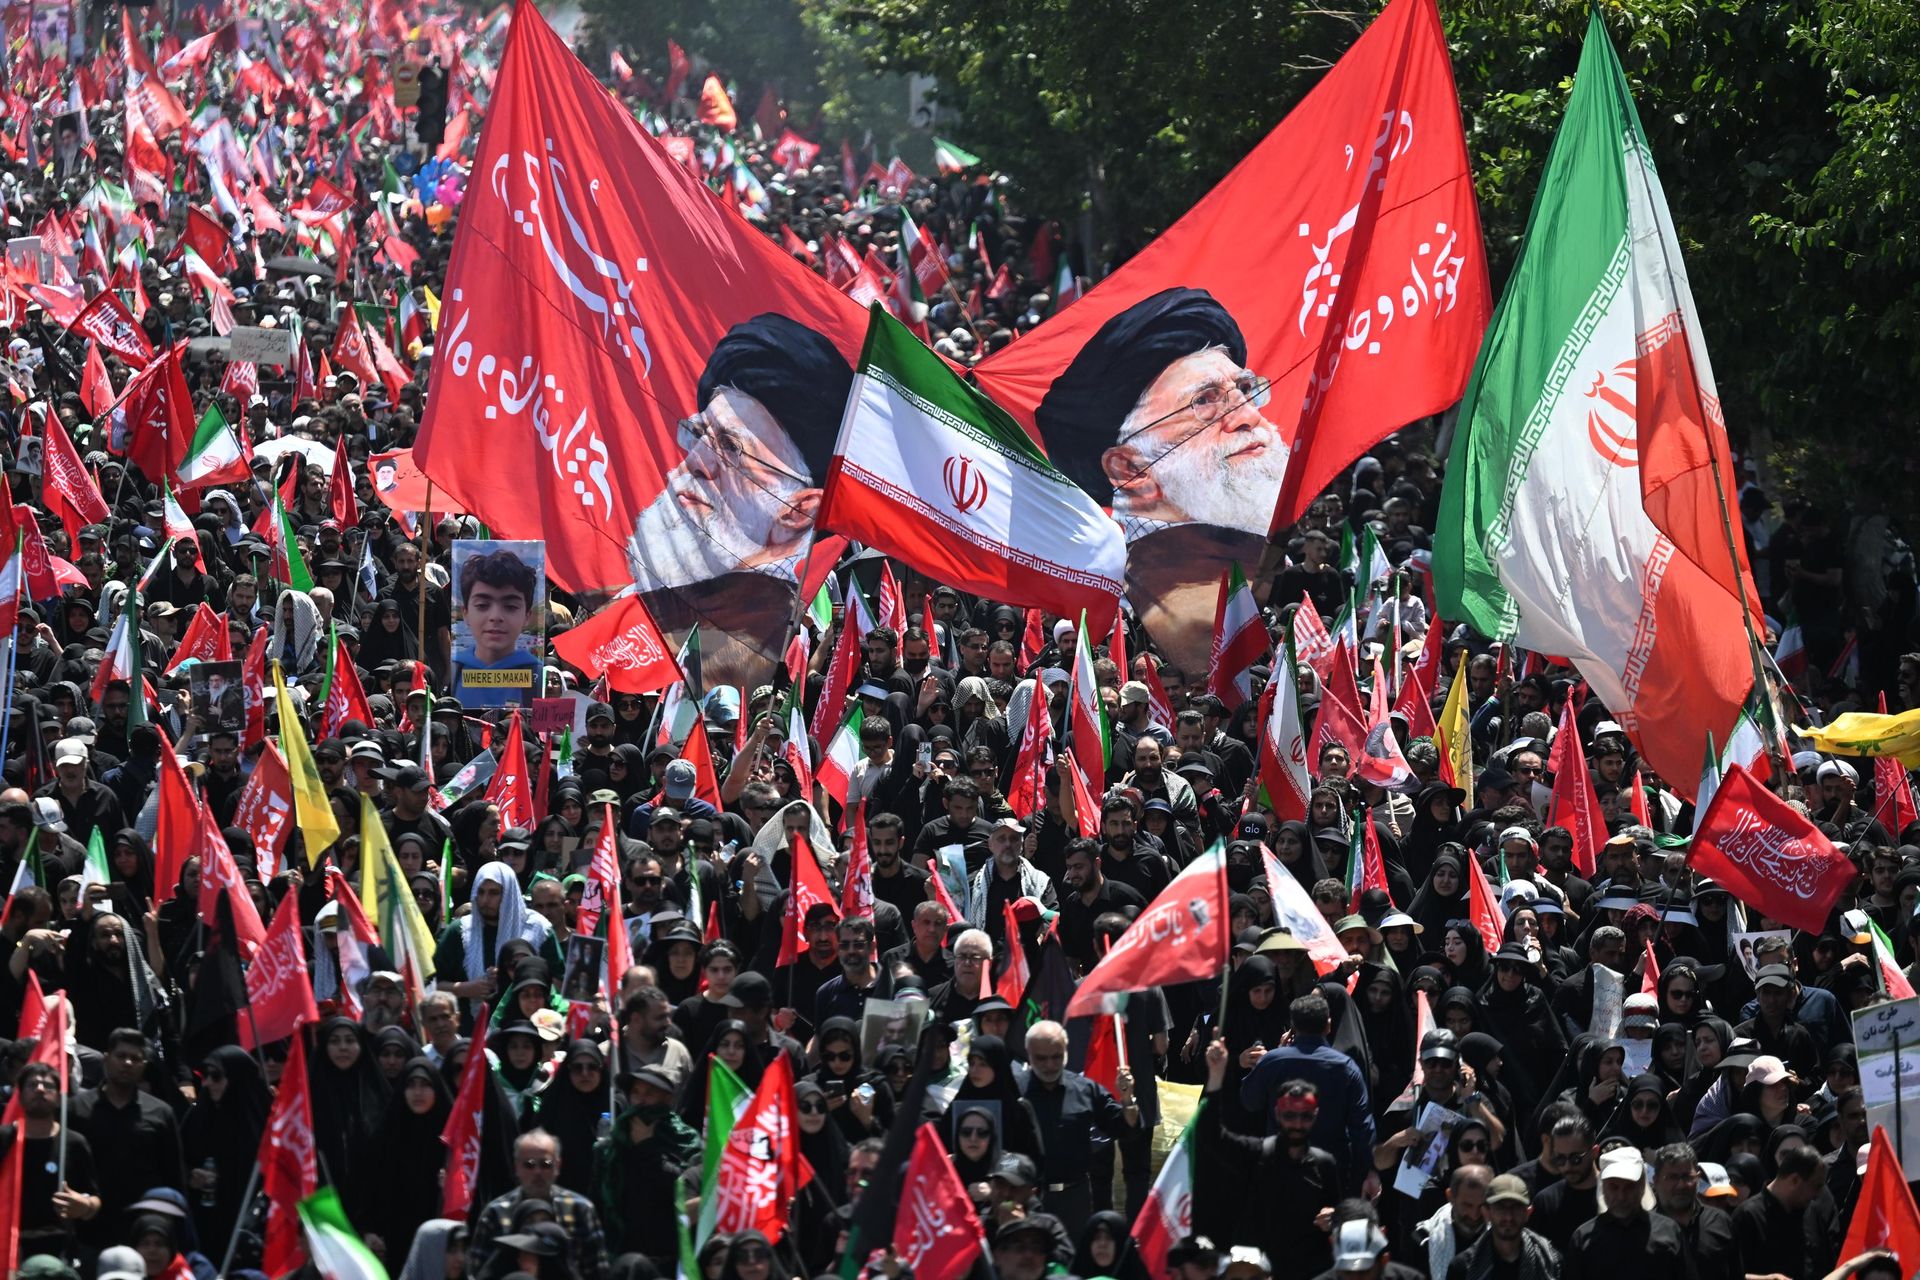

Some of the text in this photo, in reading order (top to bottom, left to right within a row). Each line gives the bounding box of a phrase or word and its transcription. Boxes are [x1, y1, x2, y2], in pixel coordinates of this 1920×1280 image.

[463, 673, 492, 683] WHERE
[493, 673, 501, 683] IS
[502, 673, 529, 683] MAKAN
[550, 705, 574, 722] Trump
[1244, 823, 1260, 834] alo
[1877, 1007, 1898, 1021] طرح
